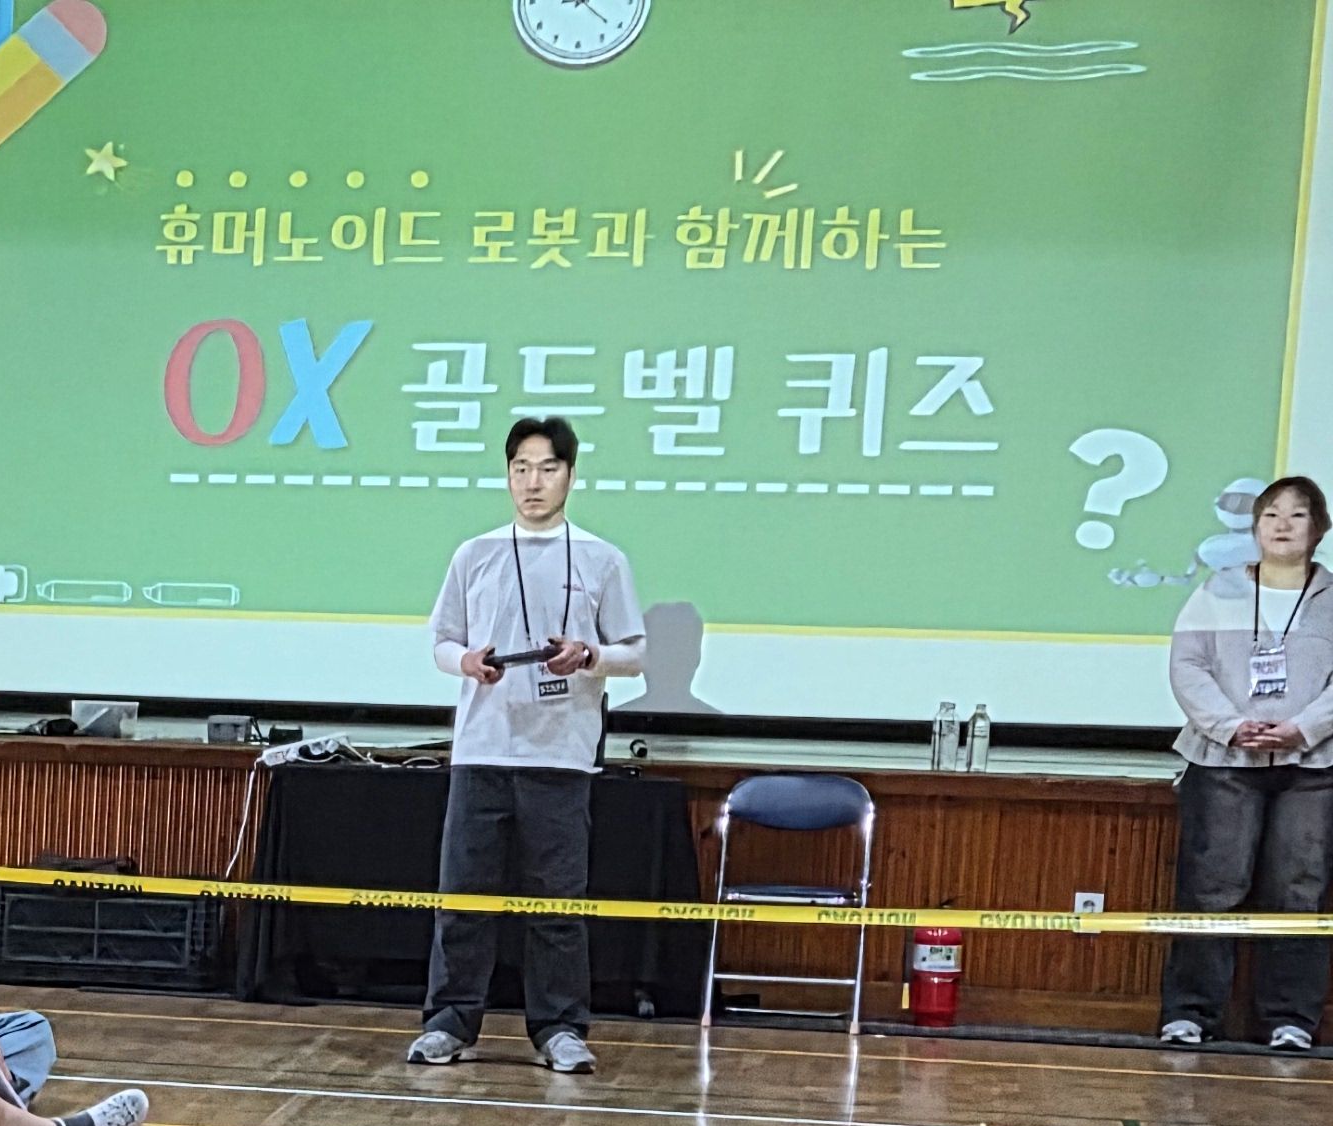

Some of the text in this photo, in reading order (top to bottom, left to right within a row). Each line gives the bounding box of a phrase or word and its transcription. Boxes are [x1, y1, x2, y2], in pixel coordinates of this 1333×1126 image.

[155, 204, 948, 270] 휴머노이드 로봇과 함께하는
[164, 318, 999, 458] OX 골든벨 퀴즈
